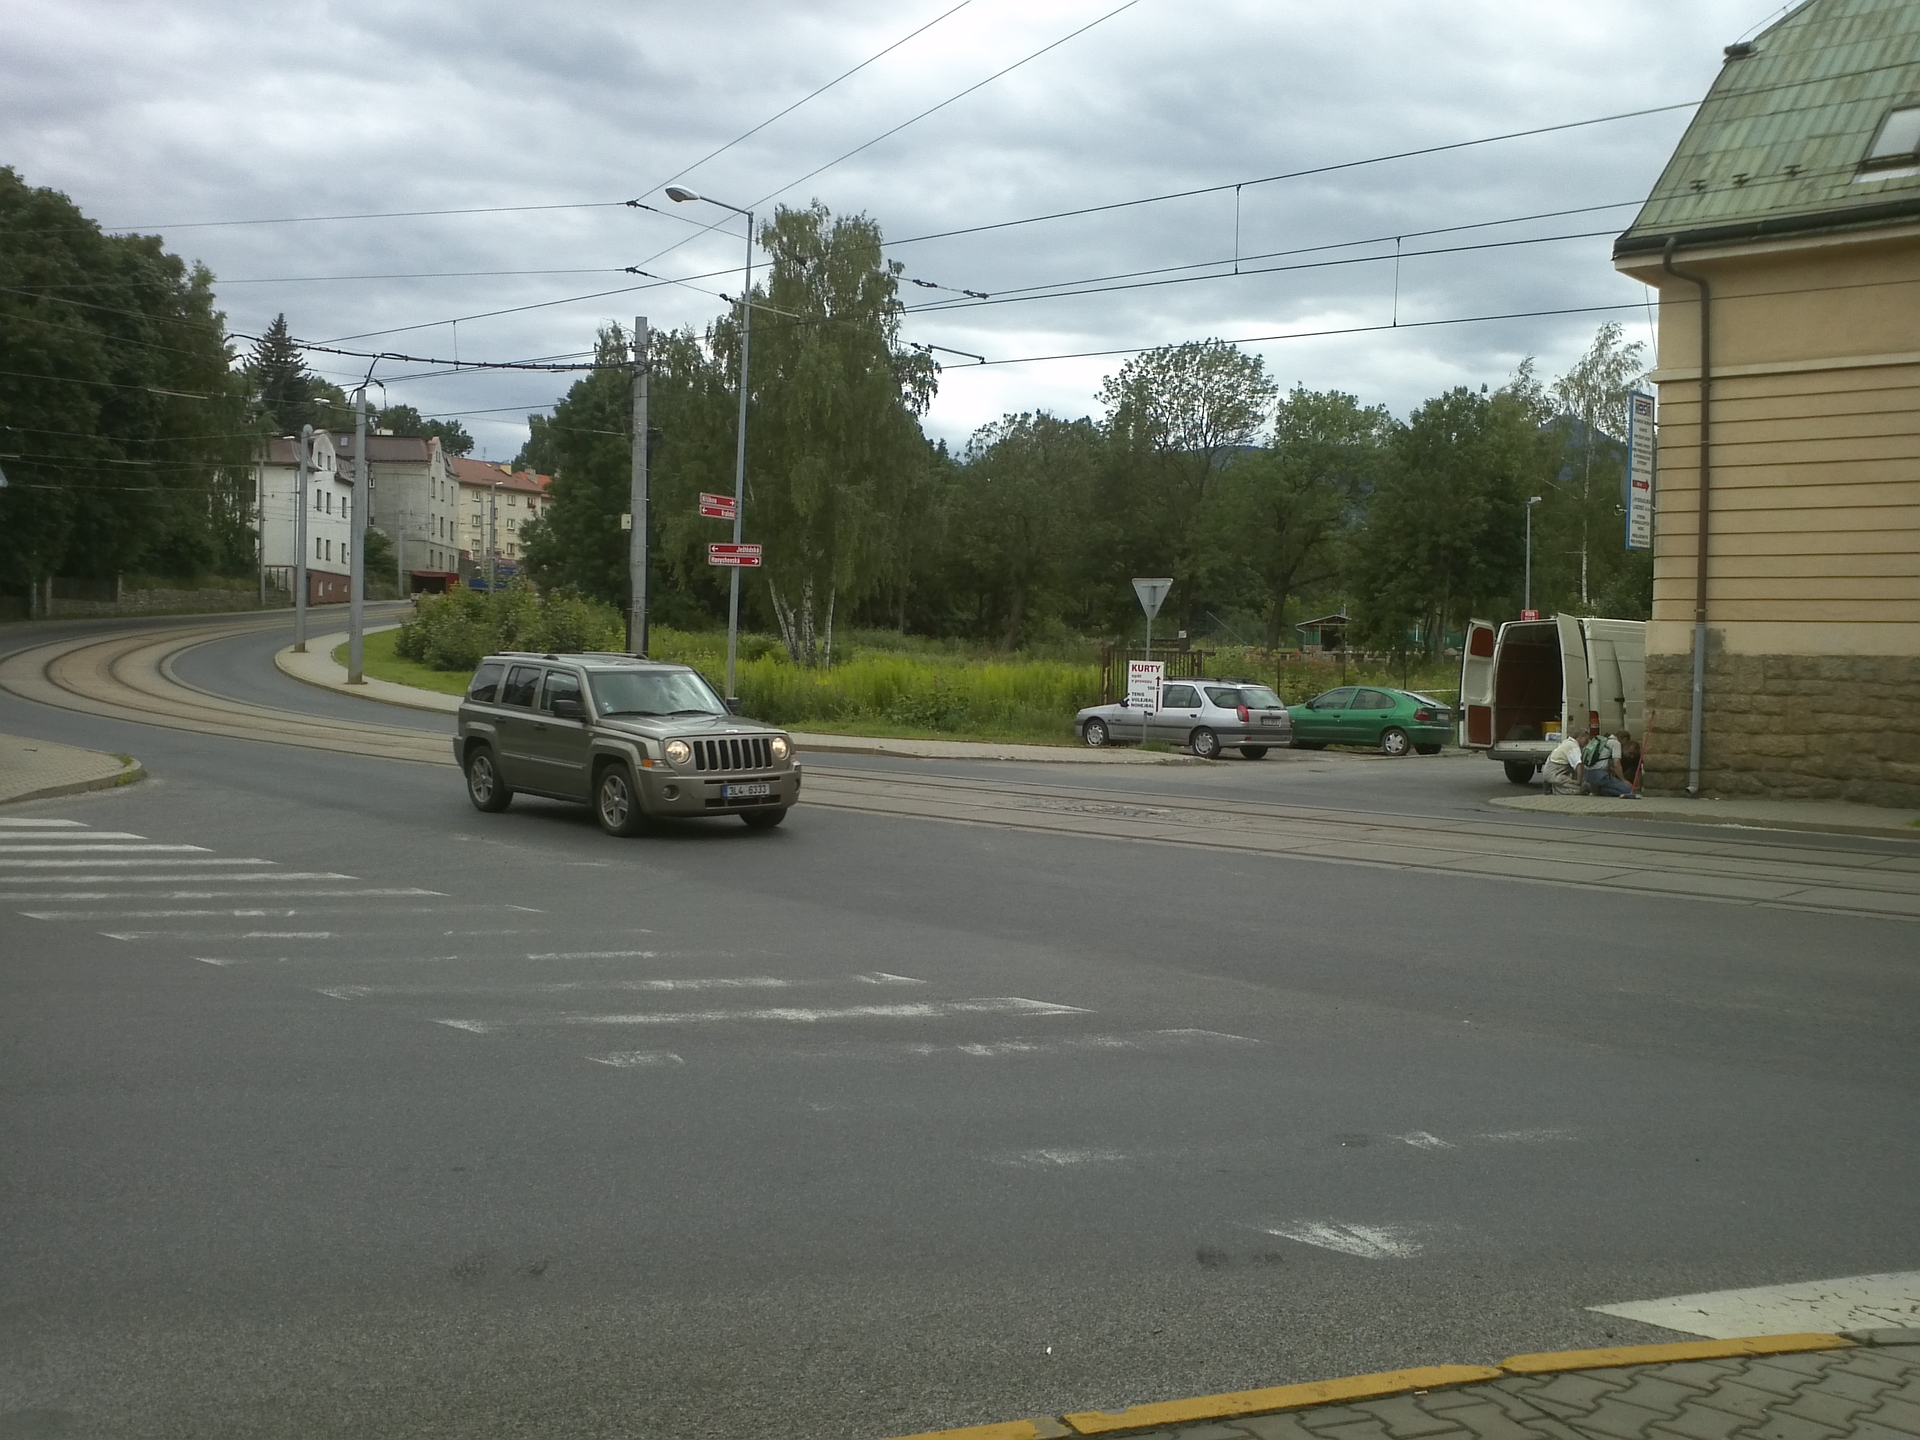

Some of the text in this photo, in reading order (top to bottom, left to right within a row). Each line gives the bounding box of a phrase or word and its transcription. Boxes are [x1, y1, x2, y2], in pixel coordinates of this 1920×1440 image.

[1132, 664, 1160, 672] KURTY
[729, 784, 766, 795] 3L4 6333
